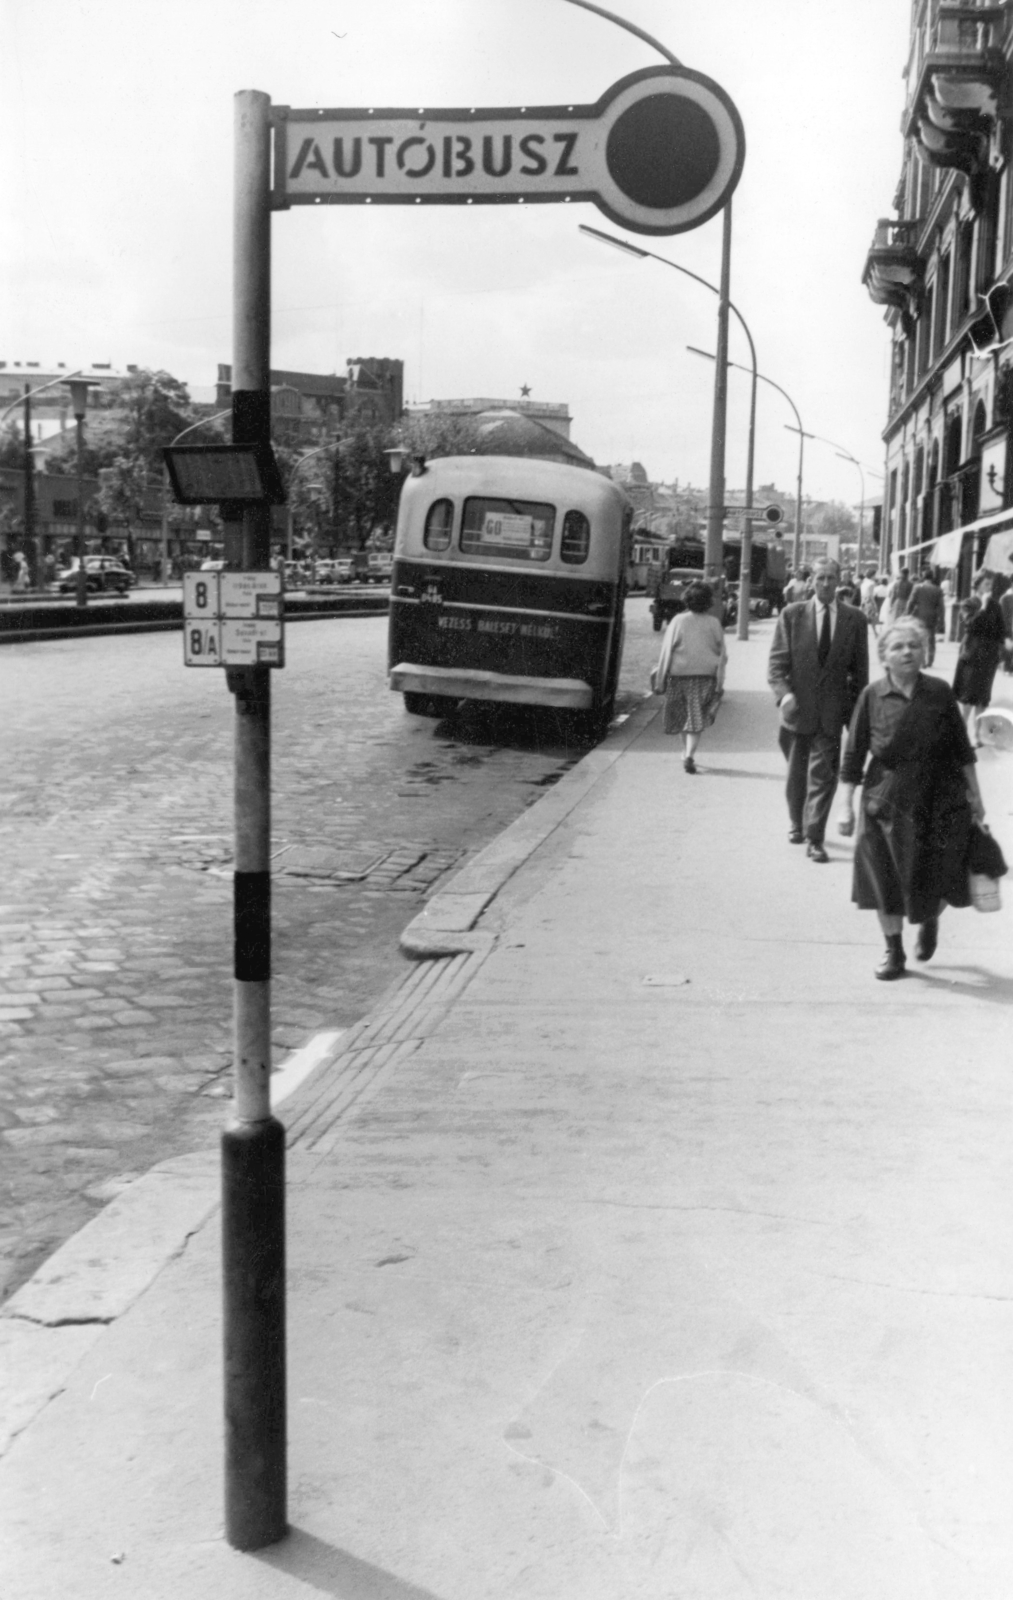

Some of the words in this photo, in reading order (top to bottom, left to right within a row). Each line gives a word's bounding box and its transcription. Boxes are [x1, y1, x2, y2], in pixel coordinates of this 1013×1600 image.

[289, 122, 580, 178] AUTÓBUSZ
[195, 581, 208, 609] 8
[438, 616, 472, 630] VEZESS
[477, 619, 517, 634] BALESET
[190, 628, 218, 656] 8/A
